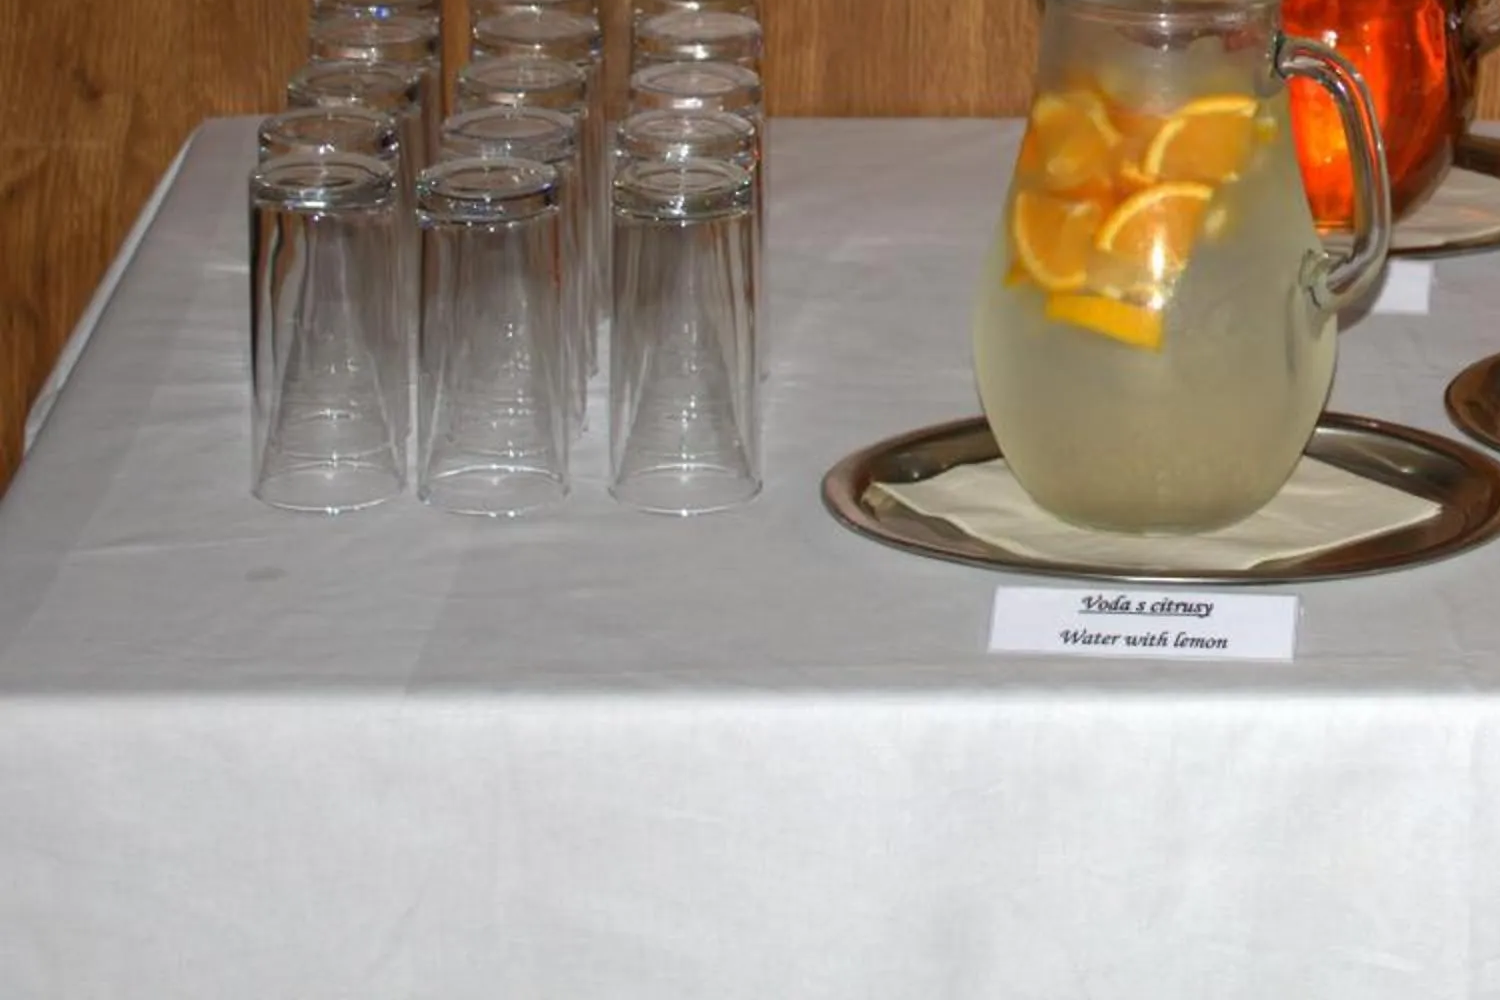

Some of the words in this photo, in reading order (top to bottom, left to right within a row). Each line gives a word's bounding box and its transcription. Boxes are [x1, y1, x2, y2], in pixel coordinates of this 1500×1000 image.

[1081, 594, 1131, 613] Voda
[1134, 600, 1147, 613] s
[1150, 597, 1214, 618] citrusy
[1060, 627, 1121, 646] Water
[1124, 631, 1169, 648] with
[1173, 631, 1229, 649] lemon
